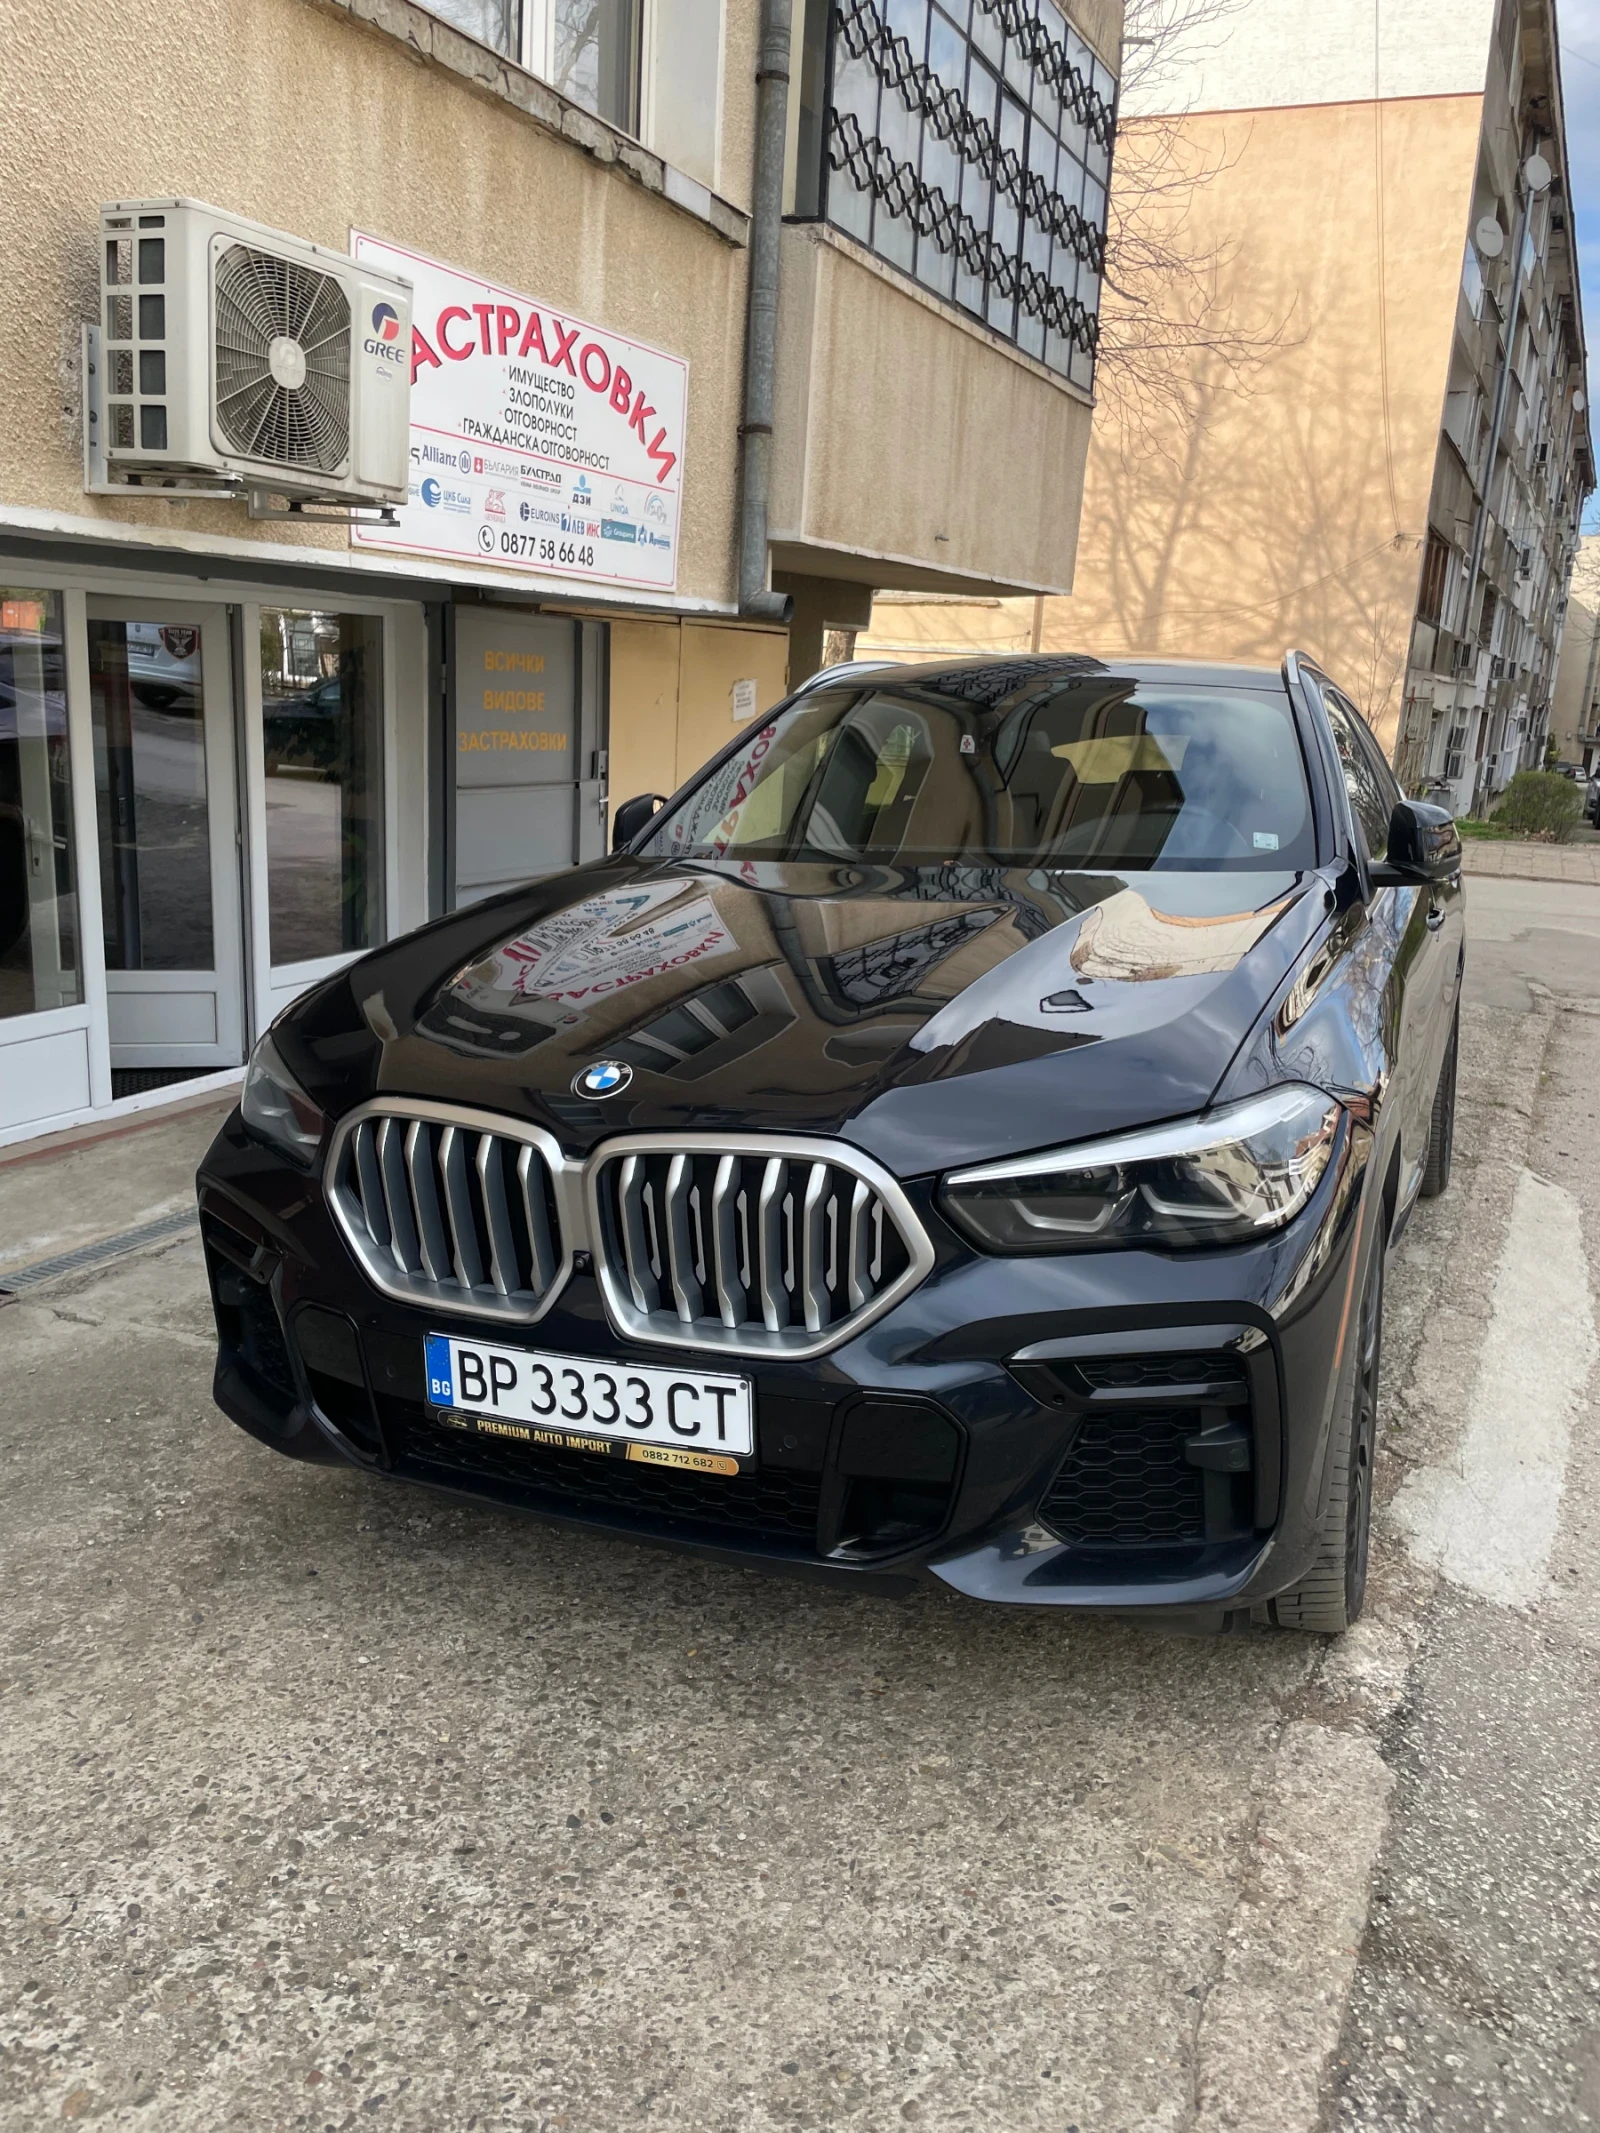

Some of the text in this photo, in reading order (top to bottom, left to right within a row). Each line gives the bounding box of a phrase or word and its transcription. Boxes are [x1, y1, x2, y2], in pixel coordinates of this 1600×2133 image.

[363, 338, 406, 364] GREE
[410, 303, 677, 484] АСТРАХОВКИ
[508, 365, 575, 400] ИМУЩЕСТВО
[509, 387, 574, 420] ЗЛОПОЛУКИ
[504, 408, 577, 442] ОТГОВОРНОСТ
[422, 444, 457, 467] Allianz
[463, 417, 609, 470] ГРАЖДАНСКА ОТГОВОРНОСТ
[484, 459, 519, 476] БЪЛГАРИЯ
[572, 493, 591, 506] ДЗИ
[530, 508, 560, 524] EUROINS
[571, 519, 585, 535] ЛЕВ
[586, 522, 600, 538] ИНС
[501, 532, 594, 566] 0877 58 66 48
[484, 650, 545, 674] ВСИЧКИ
[483, 690, 546, 713] ВИДОВЕ
[458, 730, 567, 752] ЗАСТРАХОВКИ
[431, 1378, 451, 1396] BG
[457, 1350, 737, 1441] BP 3333 CT
[477, 1419, 612, 1454] PREMIUM AUTO IMPORT
[642, 1449, 714, 1468] 0882 712 682
